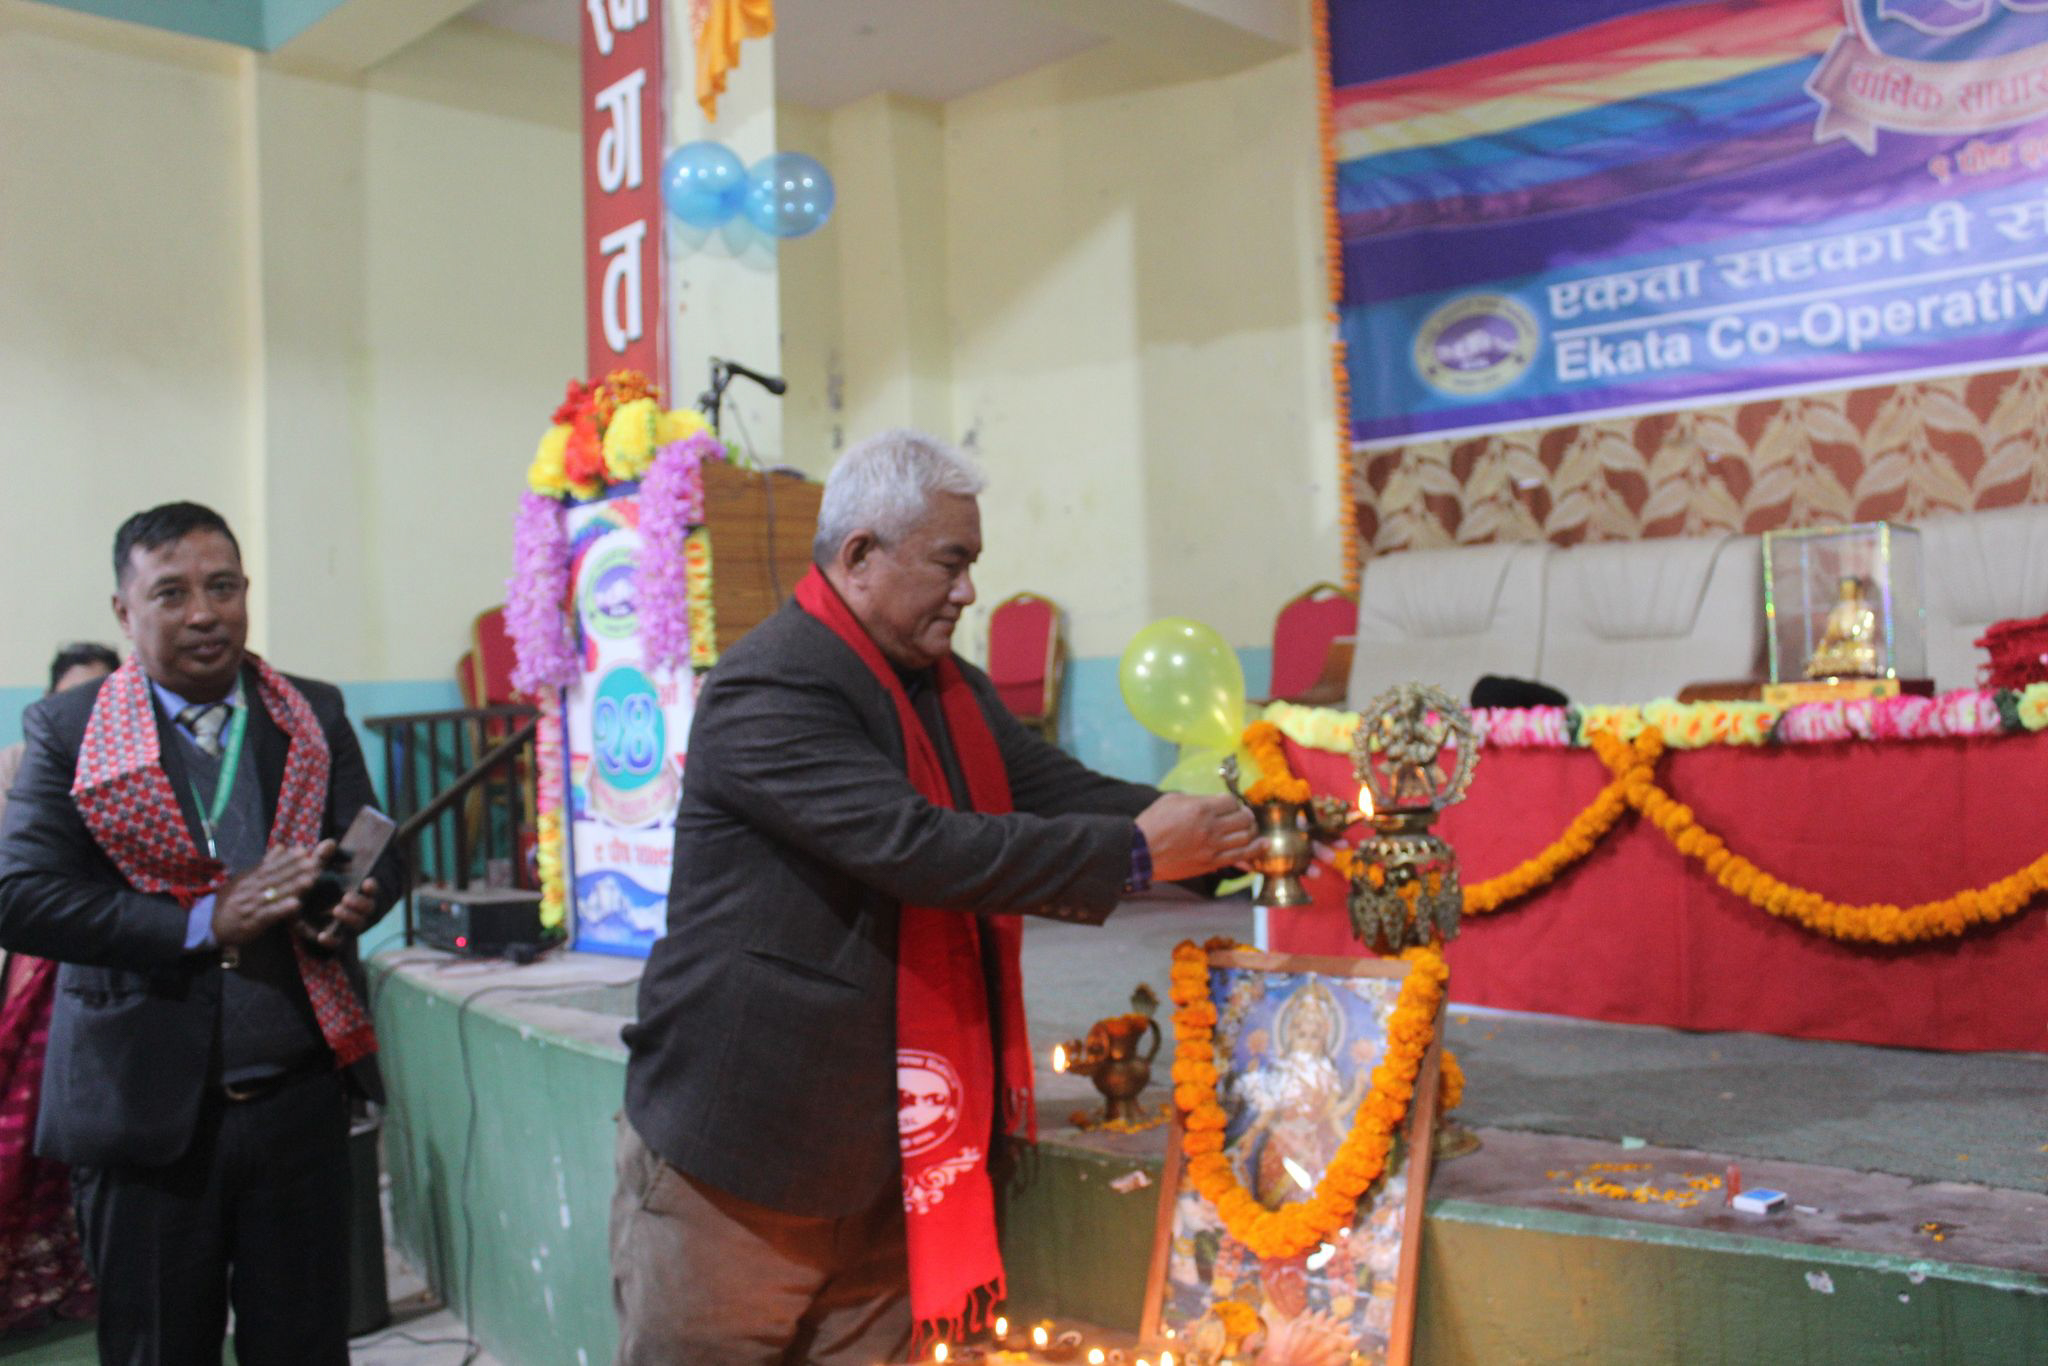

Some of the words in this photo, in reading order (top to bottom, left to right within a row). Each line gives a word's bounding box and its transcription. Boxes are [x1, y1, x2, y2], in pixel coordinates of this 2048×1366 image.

[1549, 259, 1706, 319] एकता
[1714, 199, 1976, 290] सहकारी
[1556, 330, 1693, 382] Ekata
[1707, 272, 2048, 360] Co-Operativ
